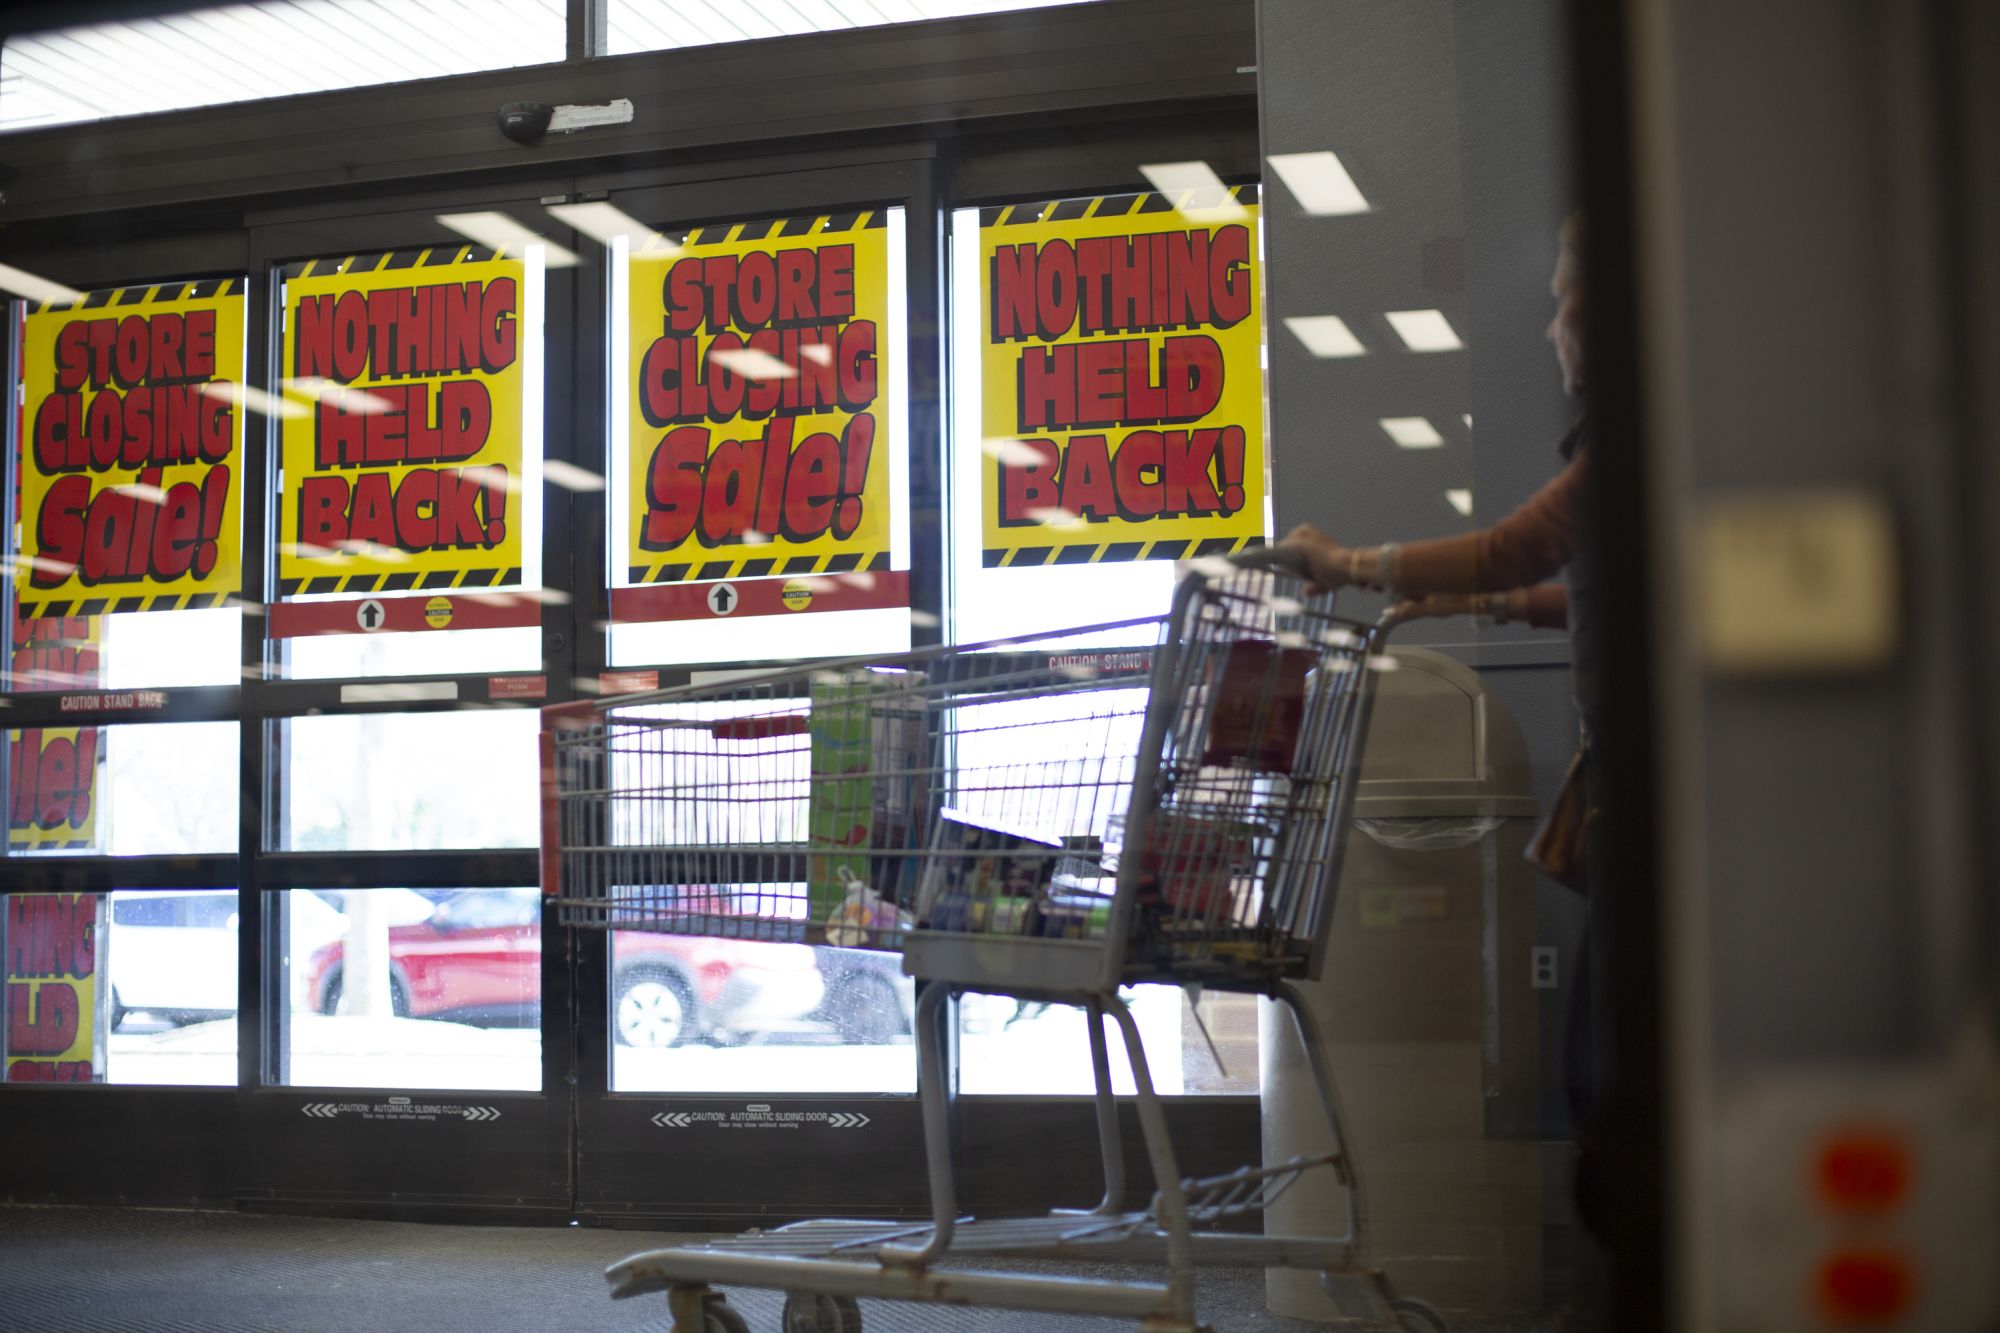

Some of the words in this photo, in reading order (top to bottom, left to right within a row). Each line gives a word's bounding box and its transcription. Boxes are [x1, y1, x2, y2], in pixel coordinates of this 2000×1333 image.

[294, 277, 517, 387] NOTHING
[663, 243, 855, 337] STORE
[991, 223, 1251, 345] NOTHING
[55, 309, 216, 392] STORE
[639, 319, 878, 429] CLOSING
[1017, 334, 1225, 433] HELD
[34, 379, 233, 476] CLOSING
[313, 379, 492, 471] HELD
[297, 463, 508, 559] BACK!
[638, 412, 876, 552] Sale!
[998, 424, 1246, 528] BACK!
[30, 464, 230, 590] Sale!
[61, 695, 99, 711] CAUTION
[103, 693, 134, 709] STAND
[138, 692, 163, 708] BACK
[1049, 655, 1098, 671] CAUTION
[1104, 652, 1142, 670] STAND
[338, 1103, 370, 1113] CAUTION:
[373, 1104, 414, 1113] AUTOMATIC
[415, 1105, 441, 1114] SLIDING
[691, 1112, 726, 1121] CAUTION:
[730, 1112, 774, 1121] AUTOMATIC
[775, 1112, 805, 1121] SLIDING
[806, 1112, 828, 1121] DOOR
